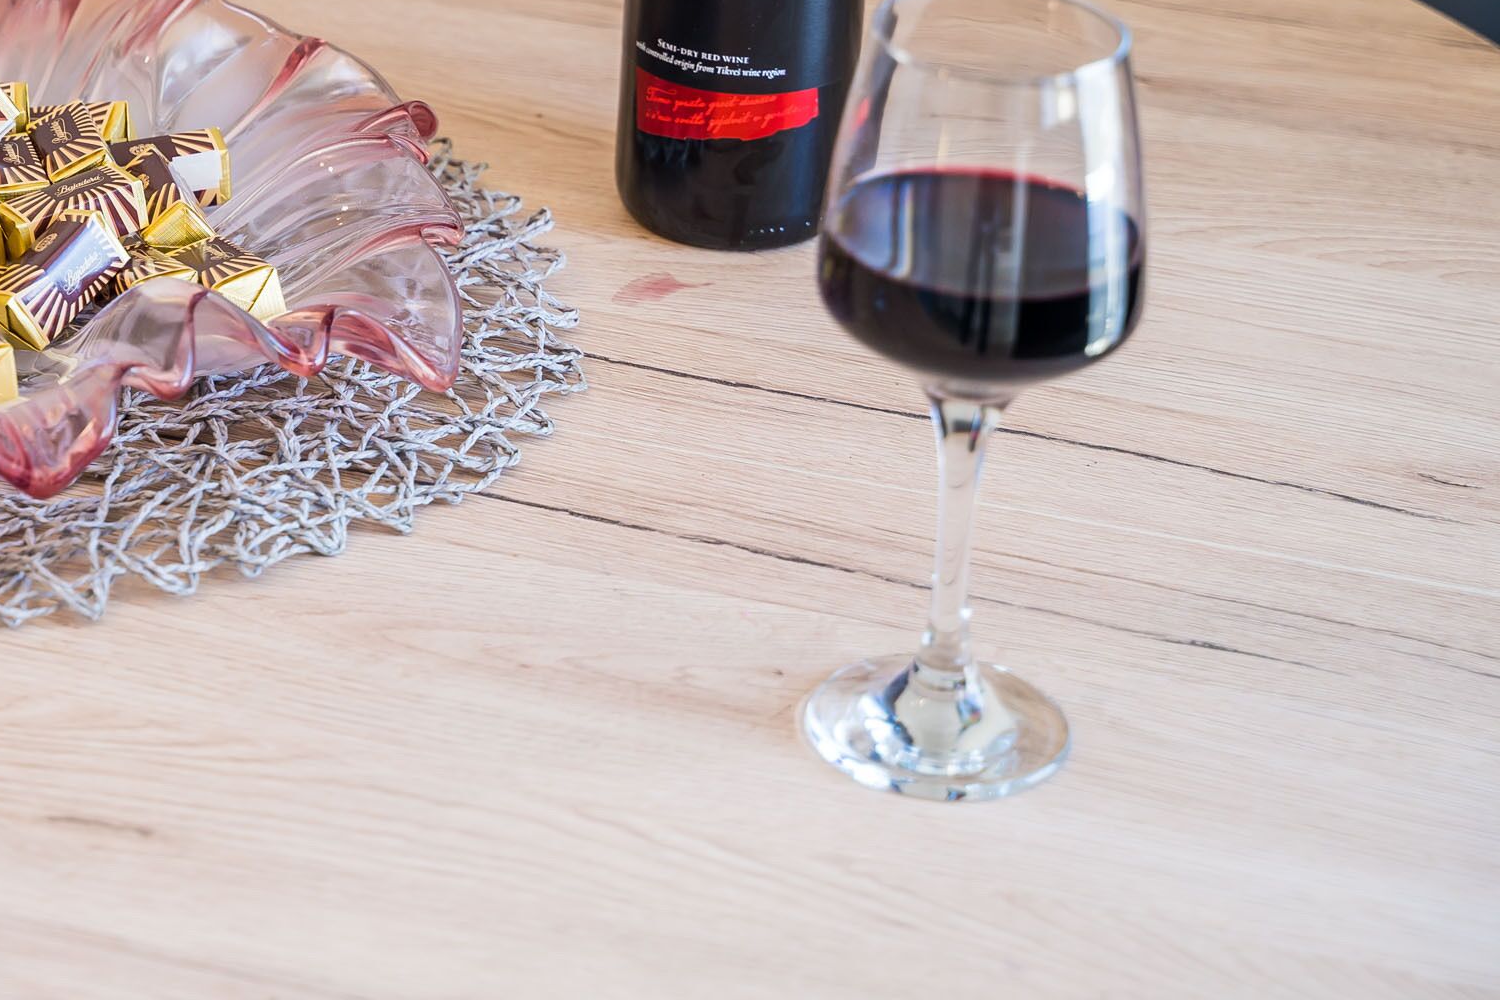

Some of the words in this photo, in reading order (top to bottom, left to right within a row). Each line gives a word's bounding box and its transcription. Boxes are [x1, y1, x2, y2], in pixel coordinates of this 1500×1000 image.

[657, 38, 699, 58] SEMI-DRY
[701, 53, 720, 62] RED
[722, 55, 749, 65] WINE
[673, 58, 695, 71] origin
[693, 61, 714, 73] from
[741, 68, 761, 77] wine
[762, 68, 787, 80] region
[54, 174, 105, 198] Bajadera
[63, 251, 102, 295] Bajadera
